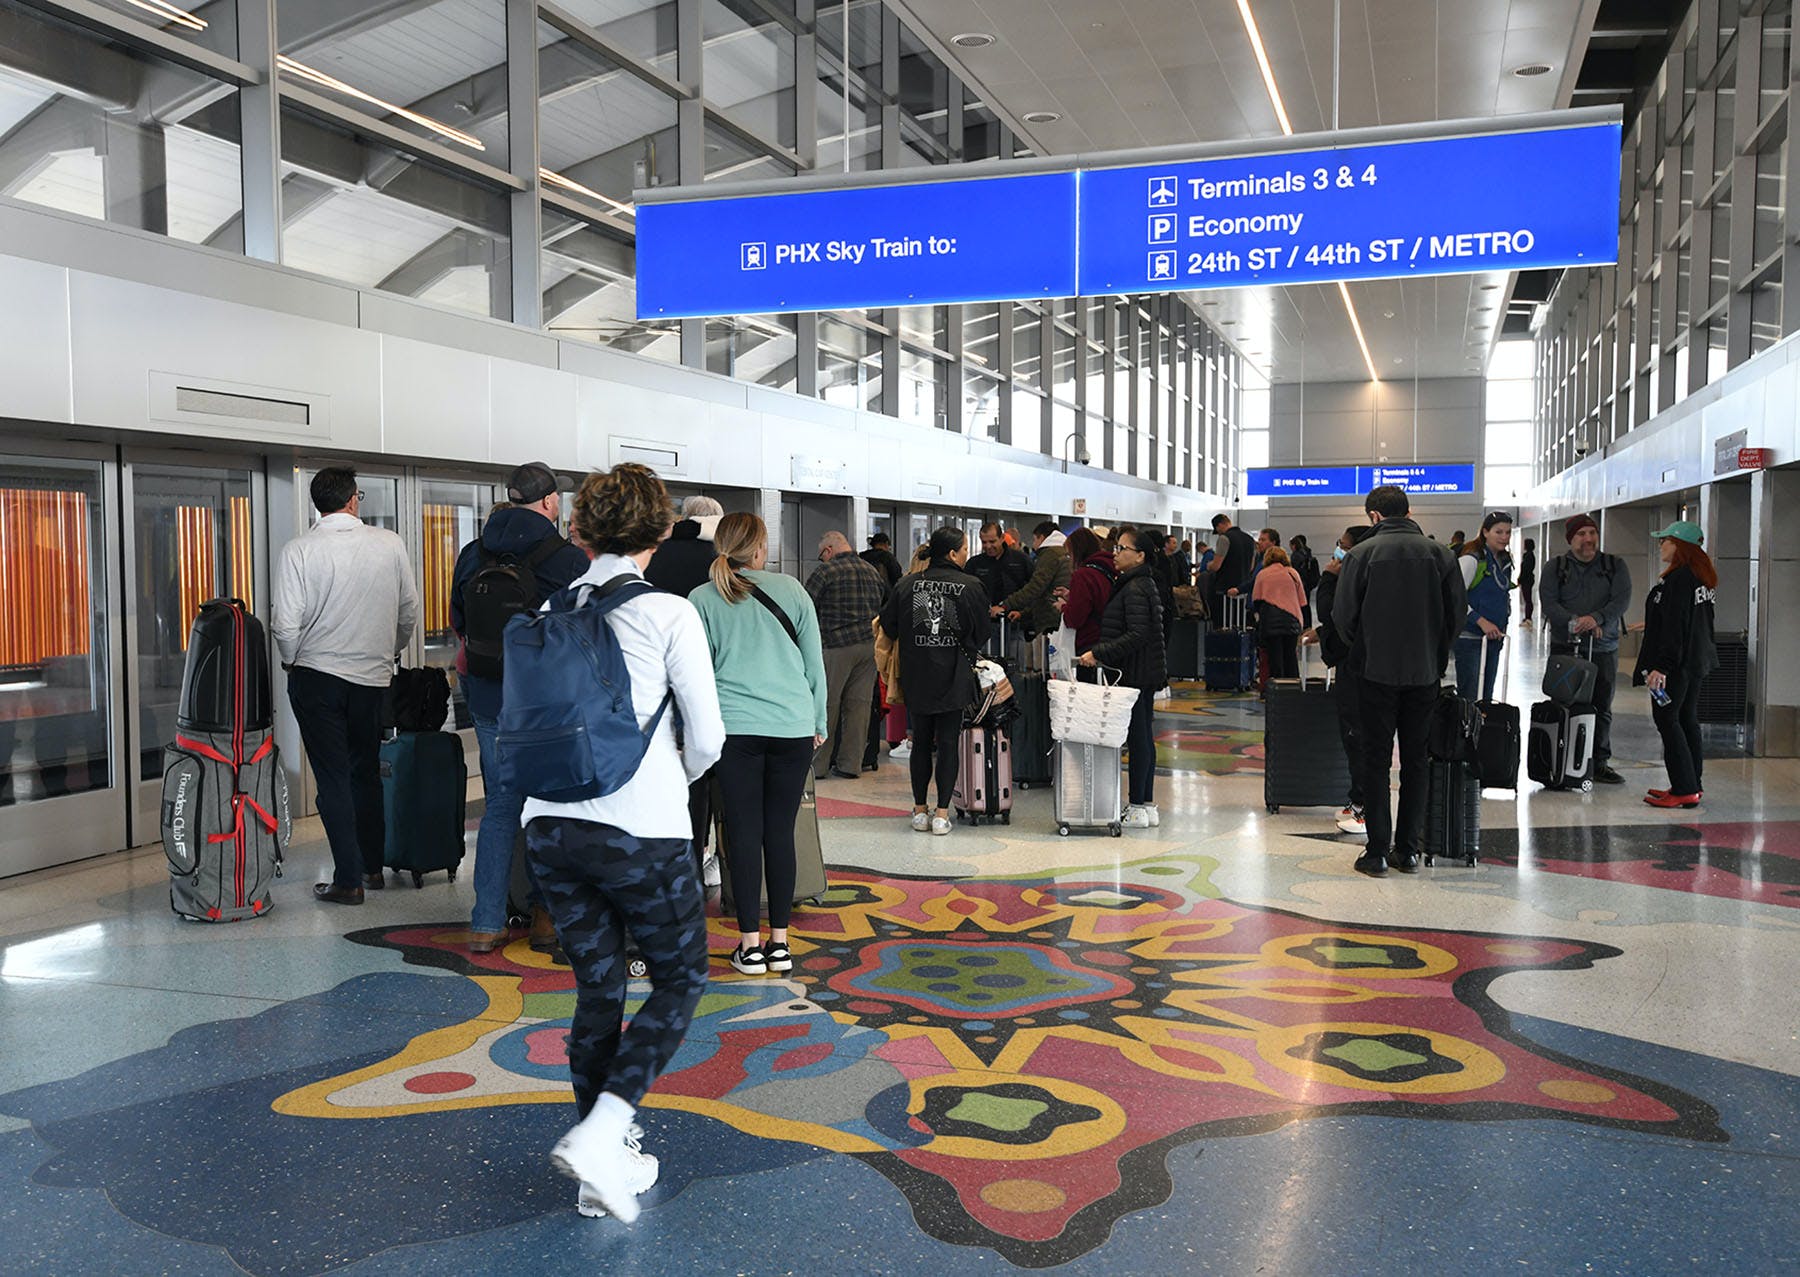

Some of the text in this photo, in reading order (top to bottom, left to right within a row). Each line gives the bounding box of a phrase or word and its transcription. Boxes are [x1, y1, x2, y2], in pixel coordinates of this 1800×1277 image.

[1187, 163, 1378, 200] Terminals 3 & 4
[1188, 213, 1304, 237] Economy
[775, 235, 957, 265] PHX Sky Train to:
[1187, 229, 1535, 274] 24th ST / 44th ST / METRO
[912, 580, 966, 596] FENTY
[173, 772, 192, 841] Founders Club
